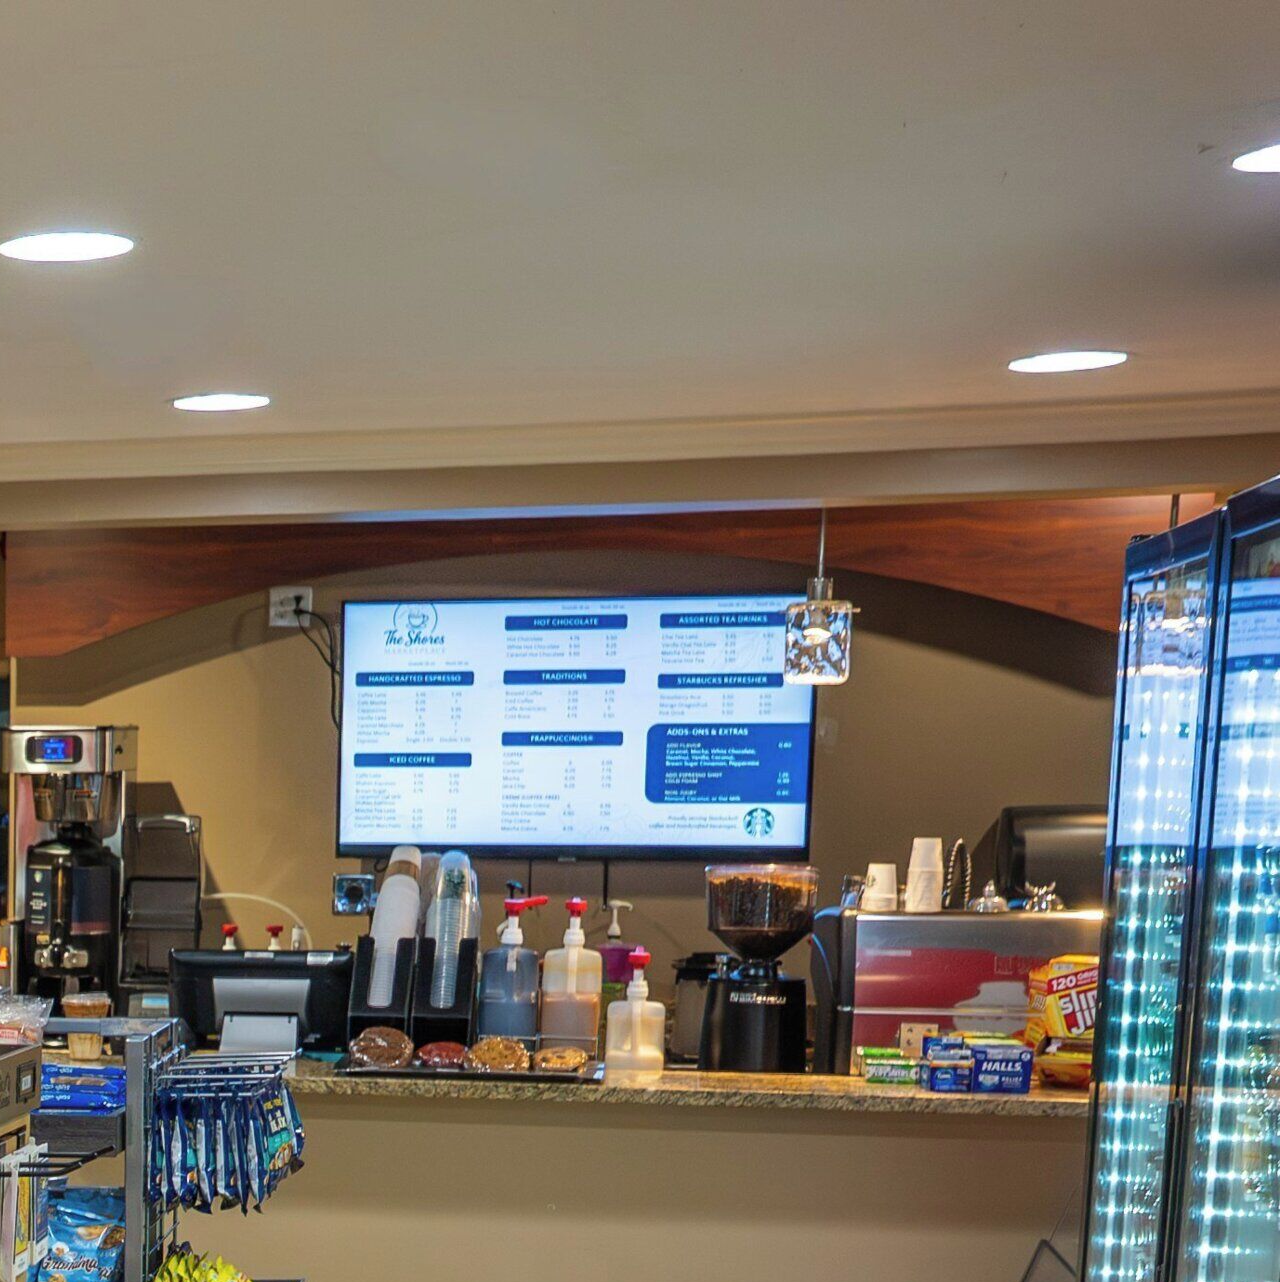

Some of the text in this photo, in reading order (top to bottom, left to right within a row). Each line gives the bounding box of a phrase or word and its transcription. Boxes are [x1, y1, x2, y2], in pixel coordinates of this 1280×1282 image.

[534, 617, 598, 627] HOT CHOCOLATE
[679, 615, 768, 624] ASSORTED TEA DRINKS
[384, 629, 444, 646] The Shores
[368, 674, 461, 683] HANDCRAFTED ESPRESSO
[542, 672, 587, 680] TRADITIONS
[723, 676, 767, 684] REFRESHER
[718, 727, 748, 735] EXTRAS
[1051, 975, 1077, 992] 120
[981, 1061, 1023, 1072] HALLS
